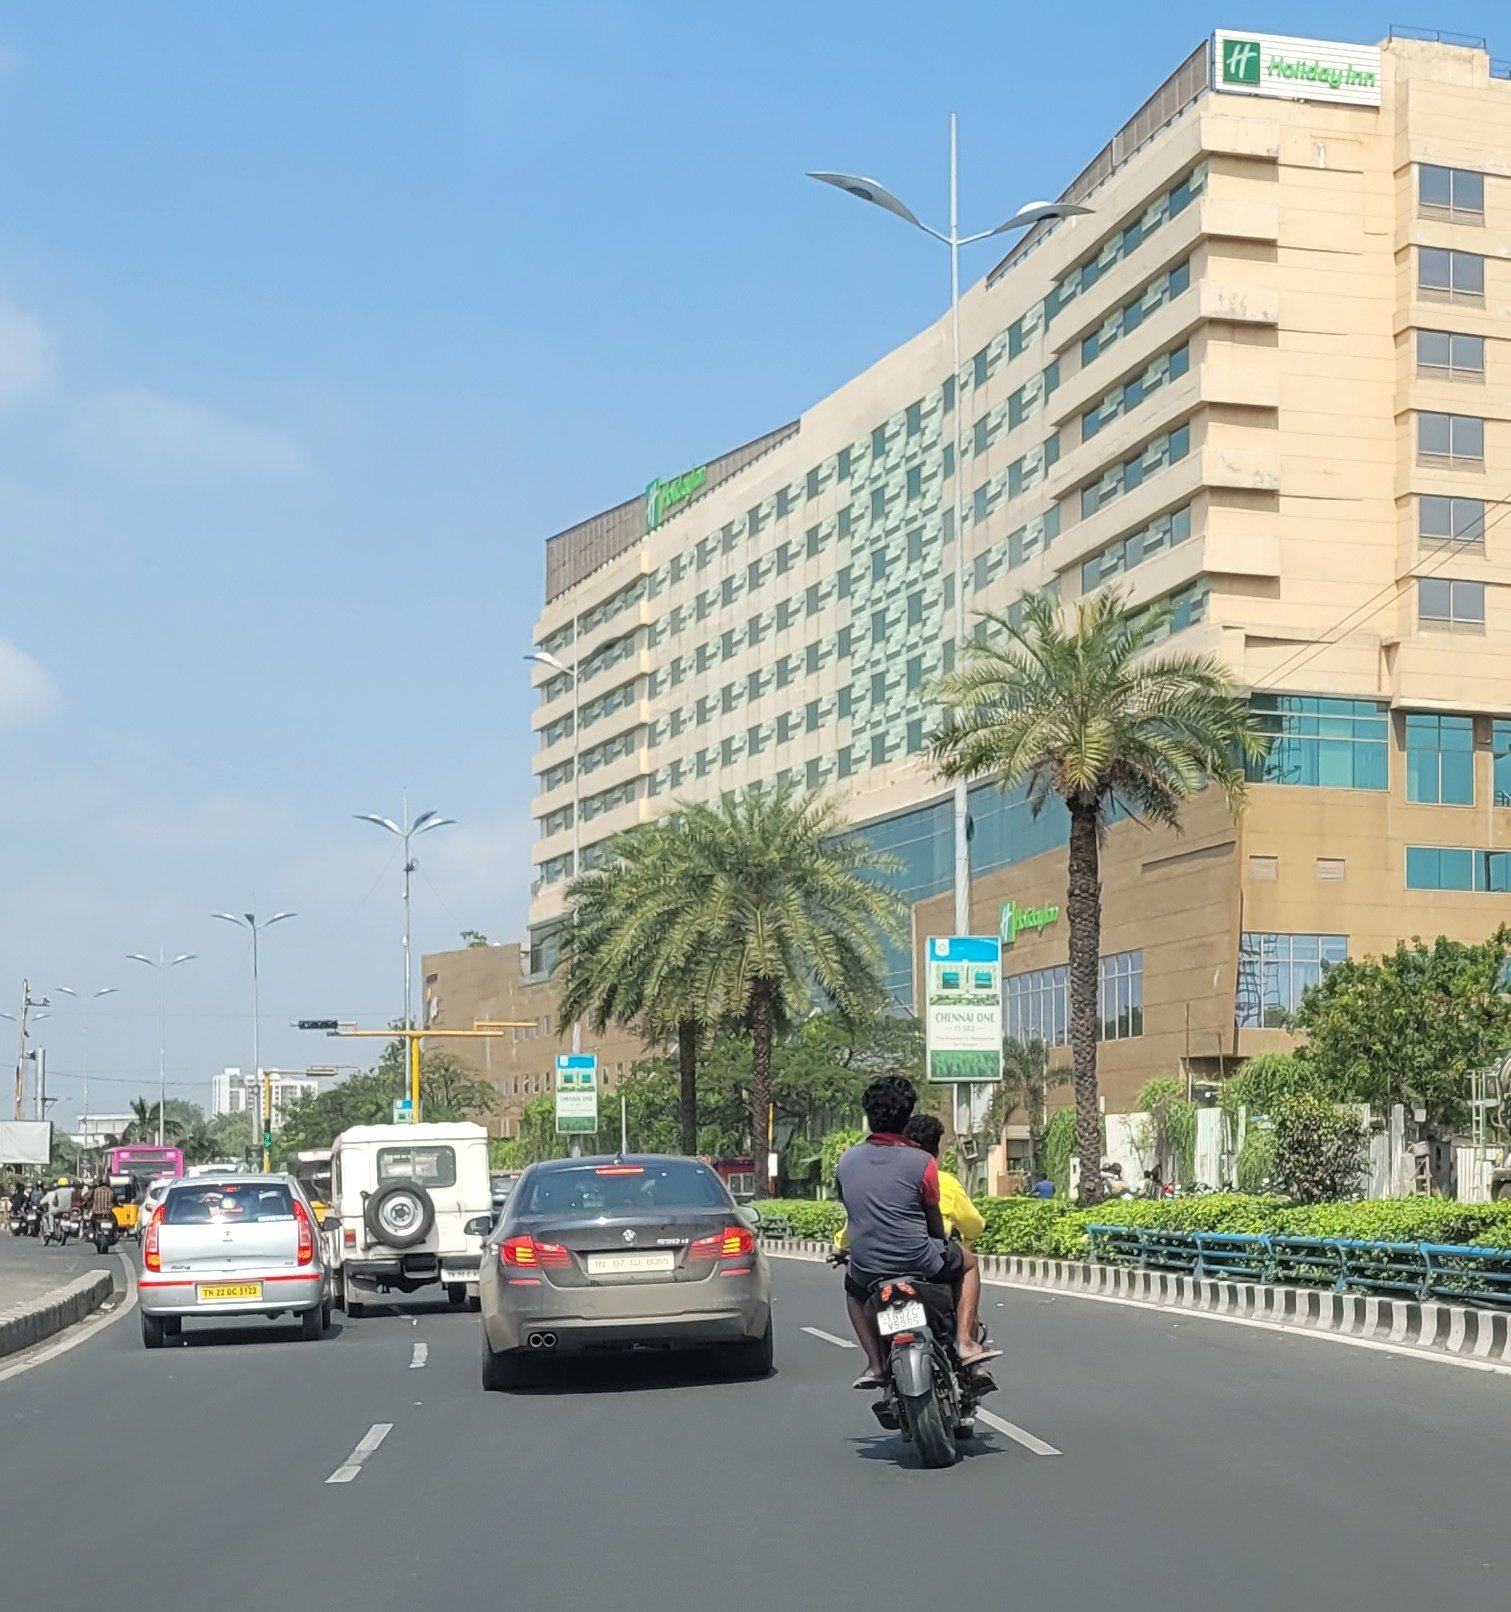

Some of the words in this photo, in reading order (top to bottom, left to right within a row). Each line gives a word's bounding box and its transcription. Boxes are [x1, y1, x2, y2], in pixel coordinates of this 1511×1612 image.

[1266, 54, 1343, 89] Holiday
[935, 1012, 974, 1024] CHENNAI
[976, 1012, 996, 1024] ONE
[203, 1289, 214, 1297] TN
